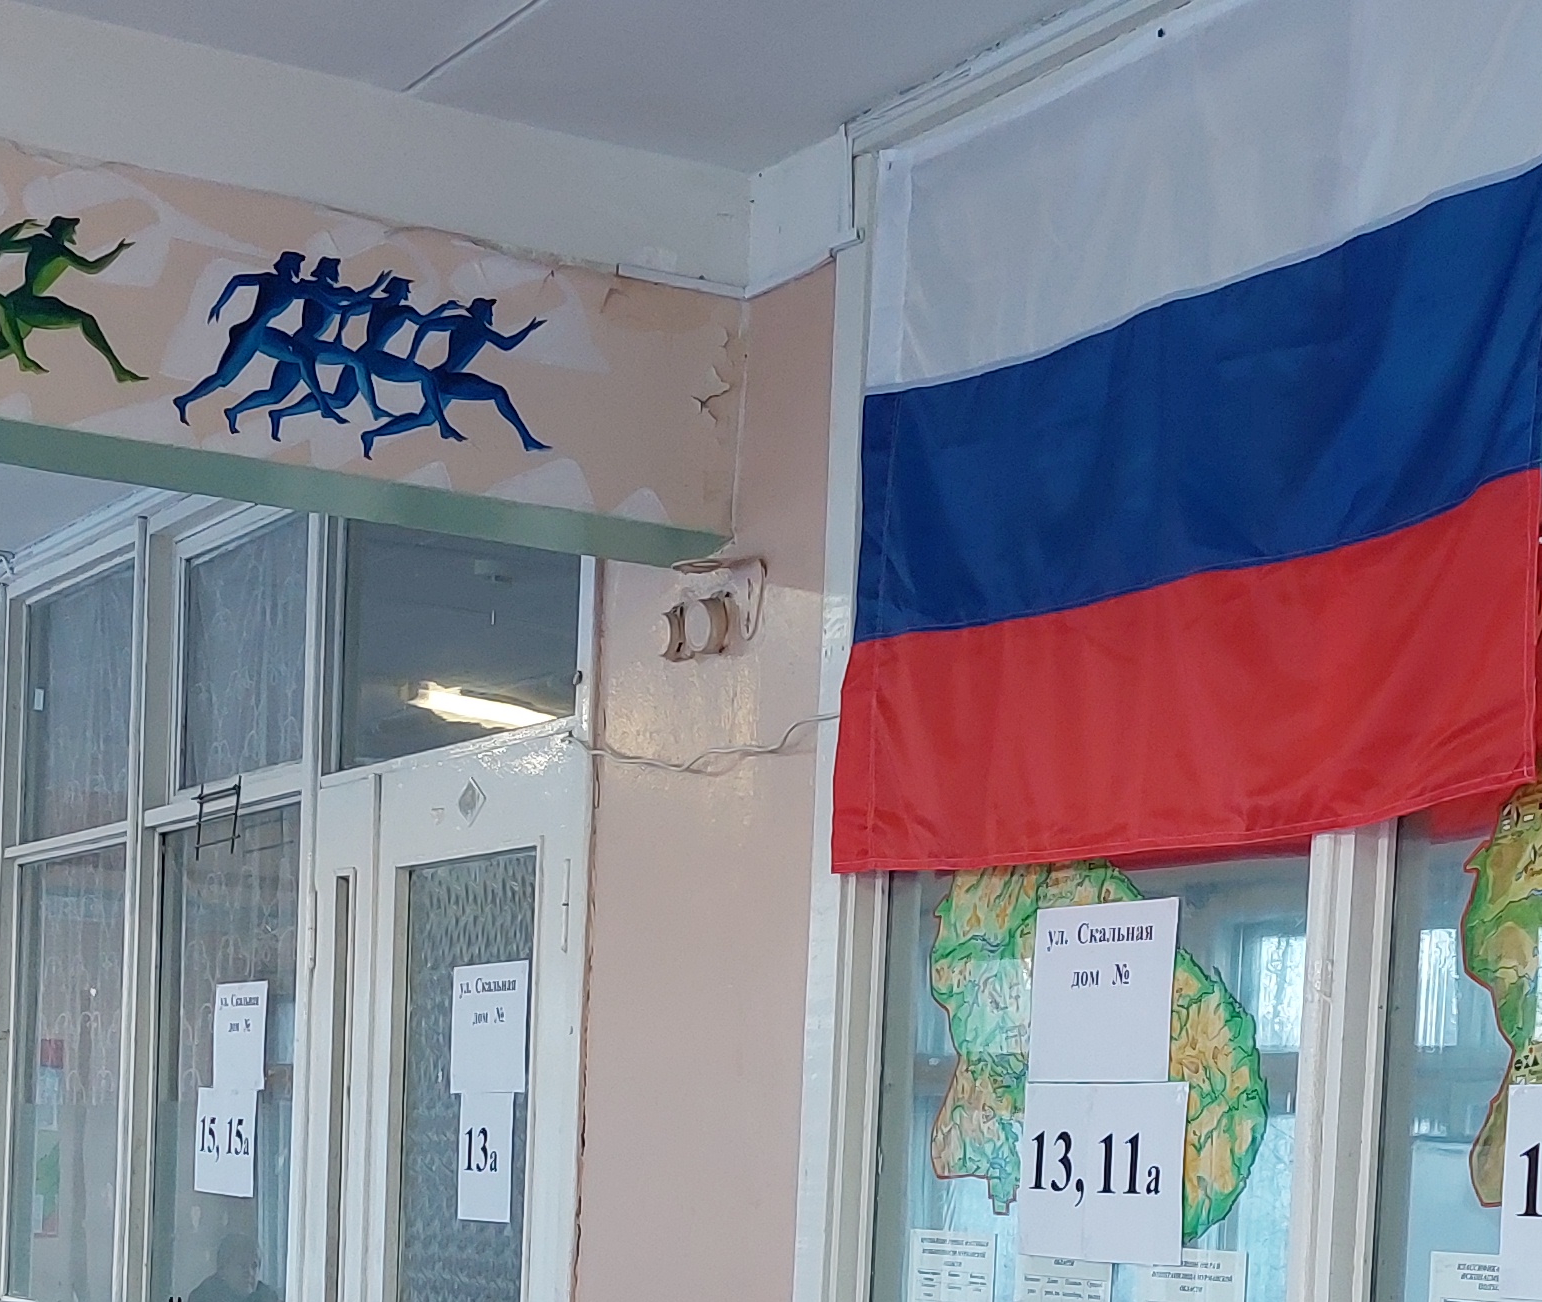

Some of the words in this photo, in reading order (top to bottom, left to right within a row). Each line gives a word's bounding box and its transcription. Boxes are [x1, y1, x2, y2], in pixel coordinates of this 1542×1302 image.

[1046, 928, 1069, 952] ул.
[1077, 922, 1154, 945] Скальная
[475, 977, 517, 994] Скальная
[1071, 968, 1100, 989] дом
[1111, 963, 1131, 986] №
[199, 1115, 220, 1163] 15,
[225, 1116, 250, 1156] 15а
[463, 1126, 498, 1173] 13а
[1028, 1130, 1086, 1208] 13,
[1096, 1131, 1162, 1196] 11а
